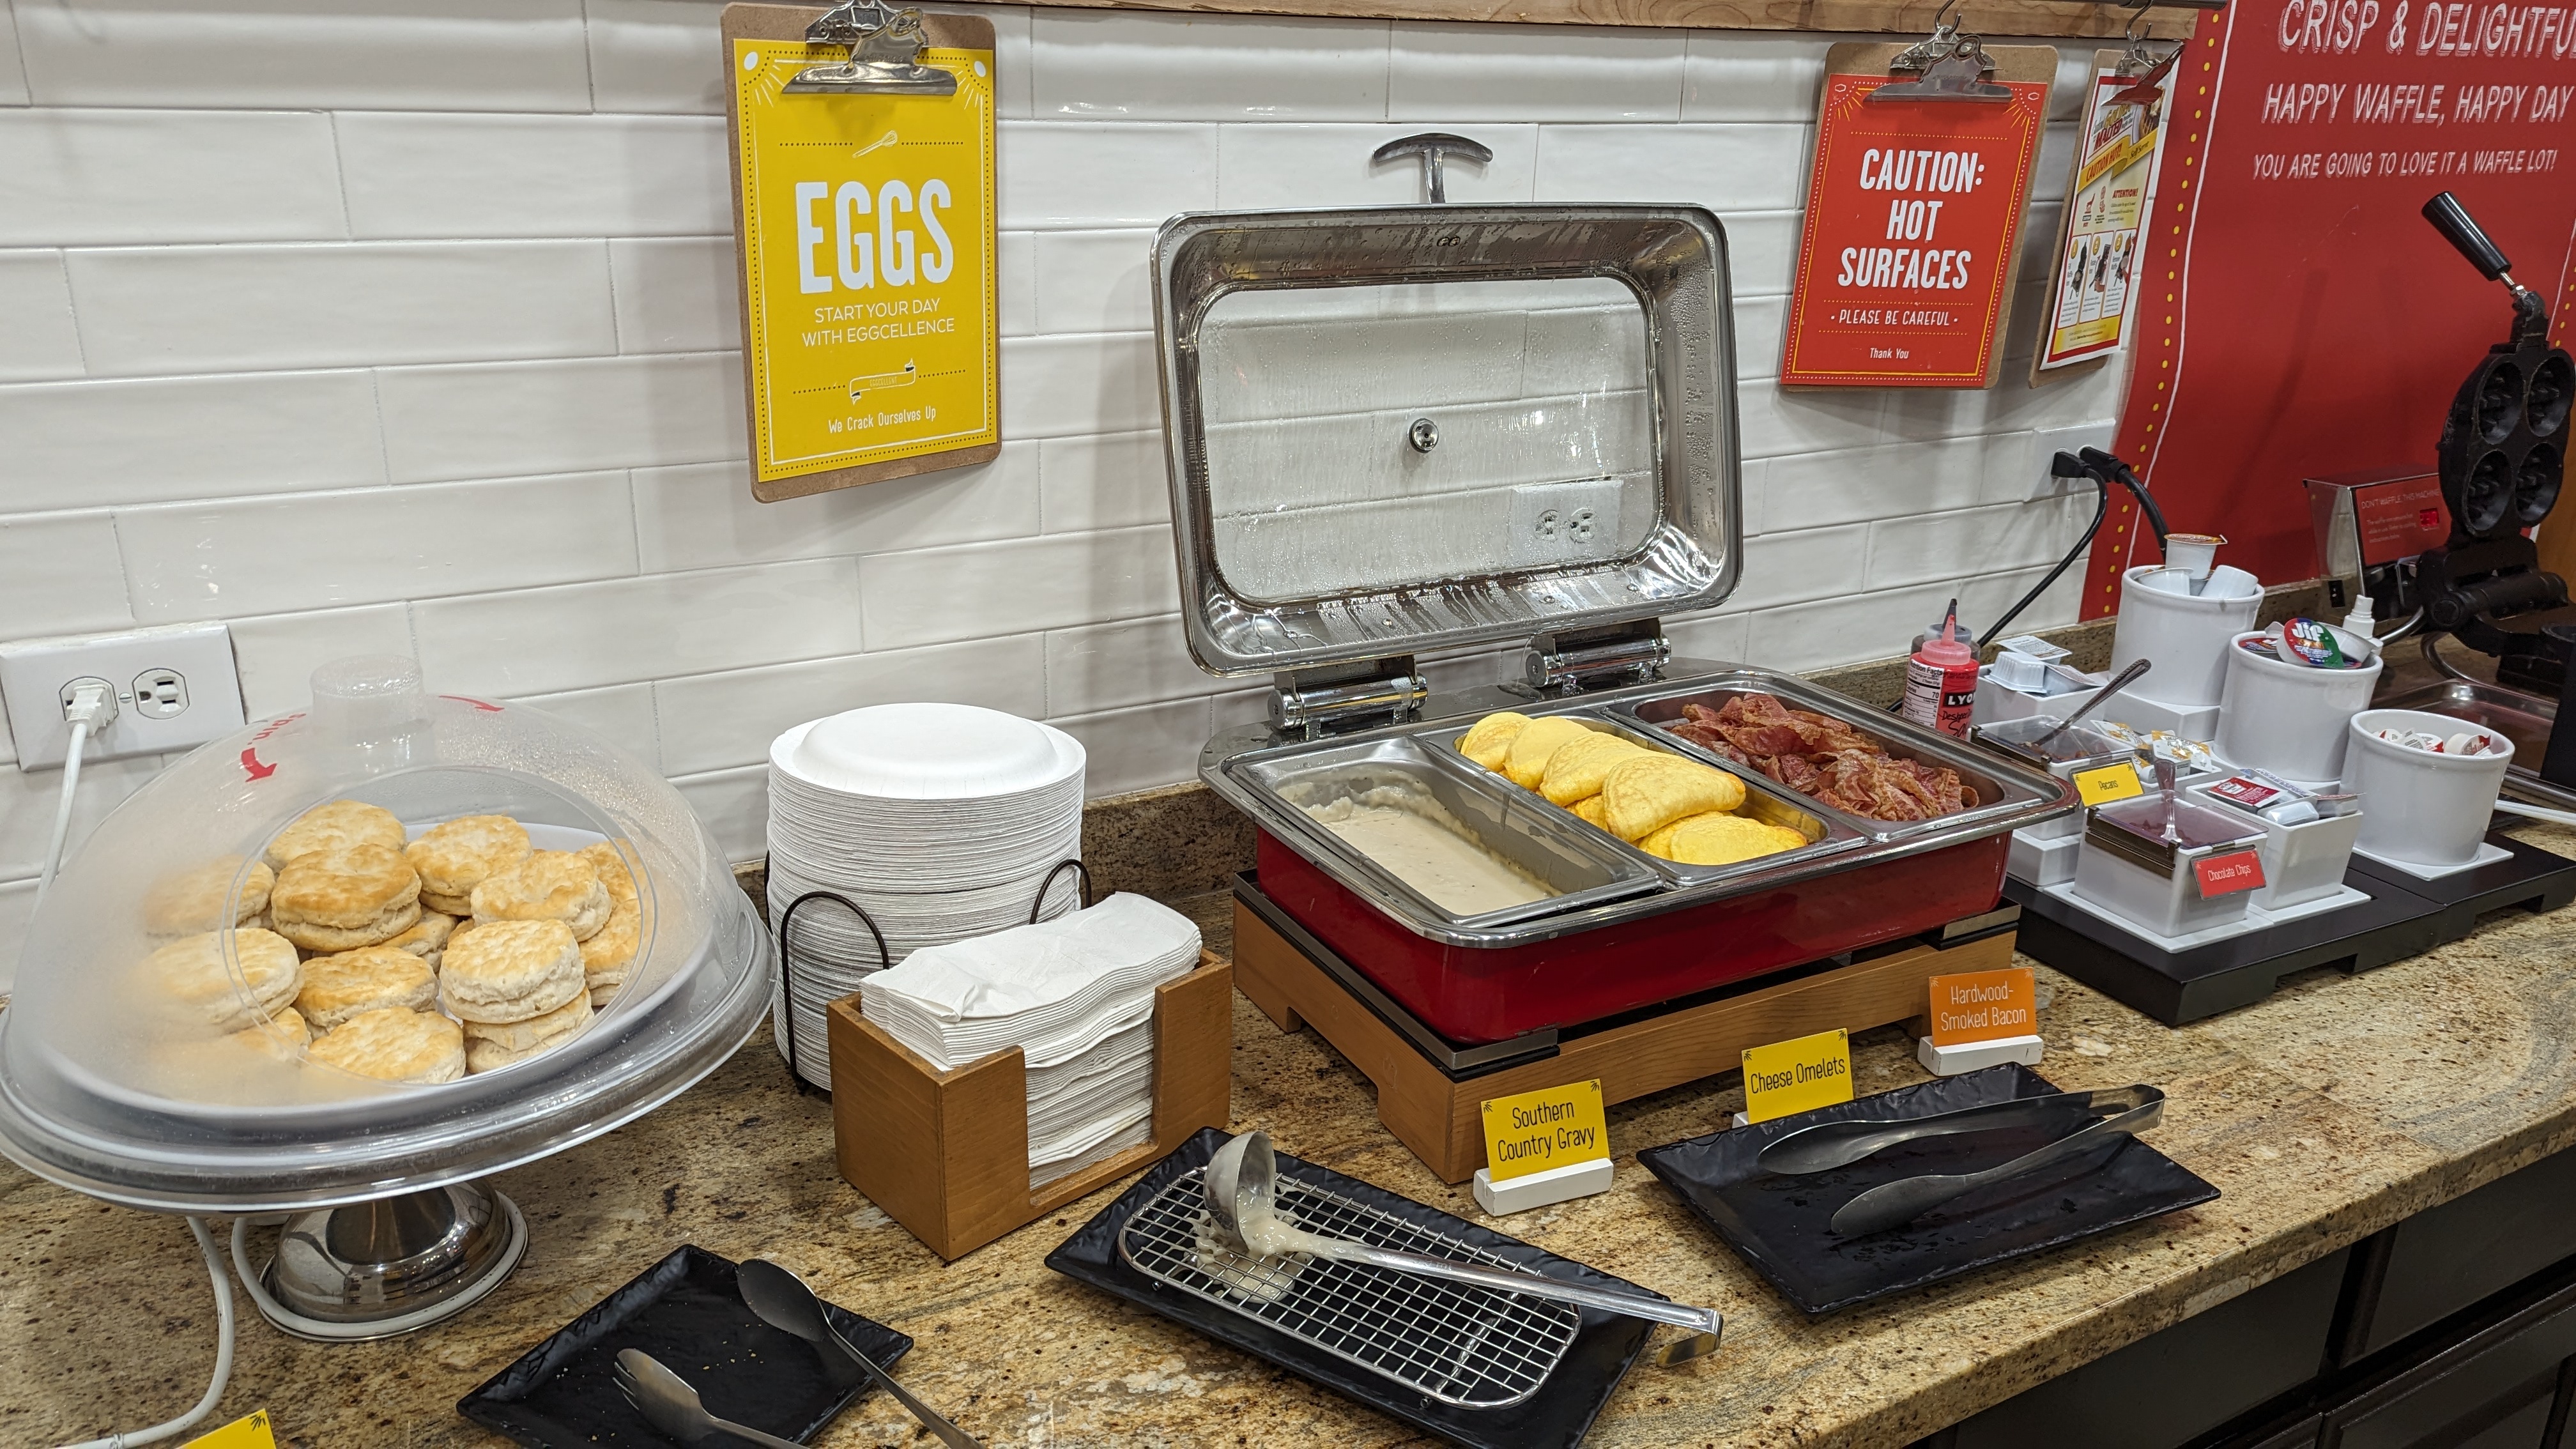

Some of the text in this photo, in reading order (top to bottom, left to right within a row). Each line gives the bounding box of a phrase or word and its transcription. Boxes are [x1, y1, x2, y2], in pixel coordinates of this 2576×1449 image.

[2278, 0, 2379, 54] CRISP
[2386, 0, 2409, 55] &
[2261, 83, 2575, 128] HAPPY WAFFLE, HAPPY DAY
[1860, 149, 1984, 193] CAUTION:
[2086, 143, 2122, 182] CAUTION HOT!
[2253, 150, 2558, 180] YOU ARE GOING TO LOVE IT A WAFFLE LOT!
[1886, 200, 1943, 241] HOT
[795, 178, 954, 293] EGGS
[1838, 248, 1971, 290] SURFACES
[815, 298, 940, 323] START YOUR DAY
[1839, 309, 1950, 326] PLEASE BE CAREFUL
[802, 318, 955, 347] WITH EGGCELLENCE
[1870, 348, 1909, 359] Thank You
[829, 406, 936, 433] We Crack Ourselves Up
[2291, 622, 2324, 643] Jif
[1927, 668, 1943, 676] Facts
[2097, 780, 2119, 791] Pecans
[2207, 864, 2251, 882] Chocolate Chips
[1951, 982, 2014, 1006] Hardwood-
[1940, 1006, 2027, 1032] Smoked Bacon
[1750, 1055, 1846, 1095] Cheese Omelets
[1512, 1099, 1575, 1130] Southern
[1497, 1123, 1596, 1163] Country Gravy
